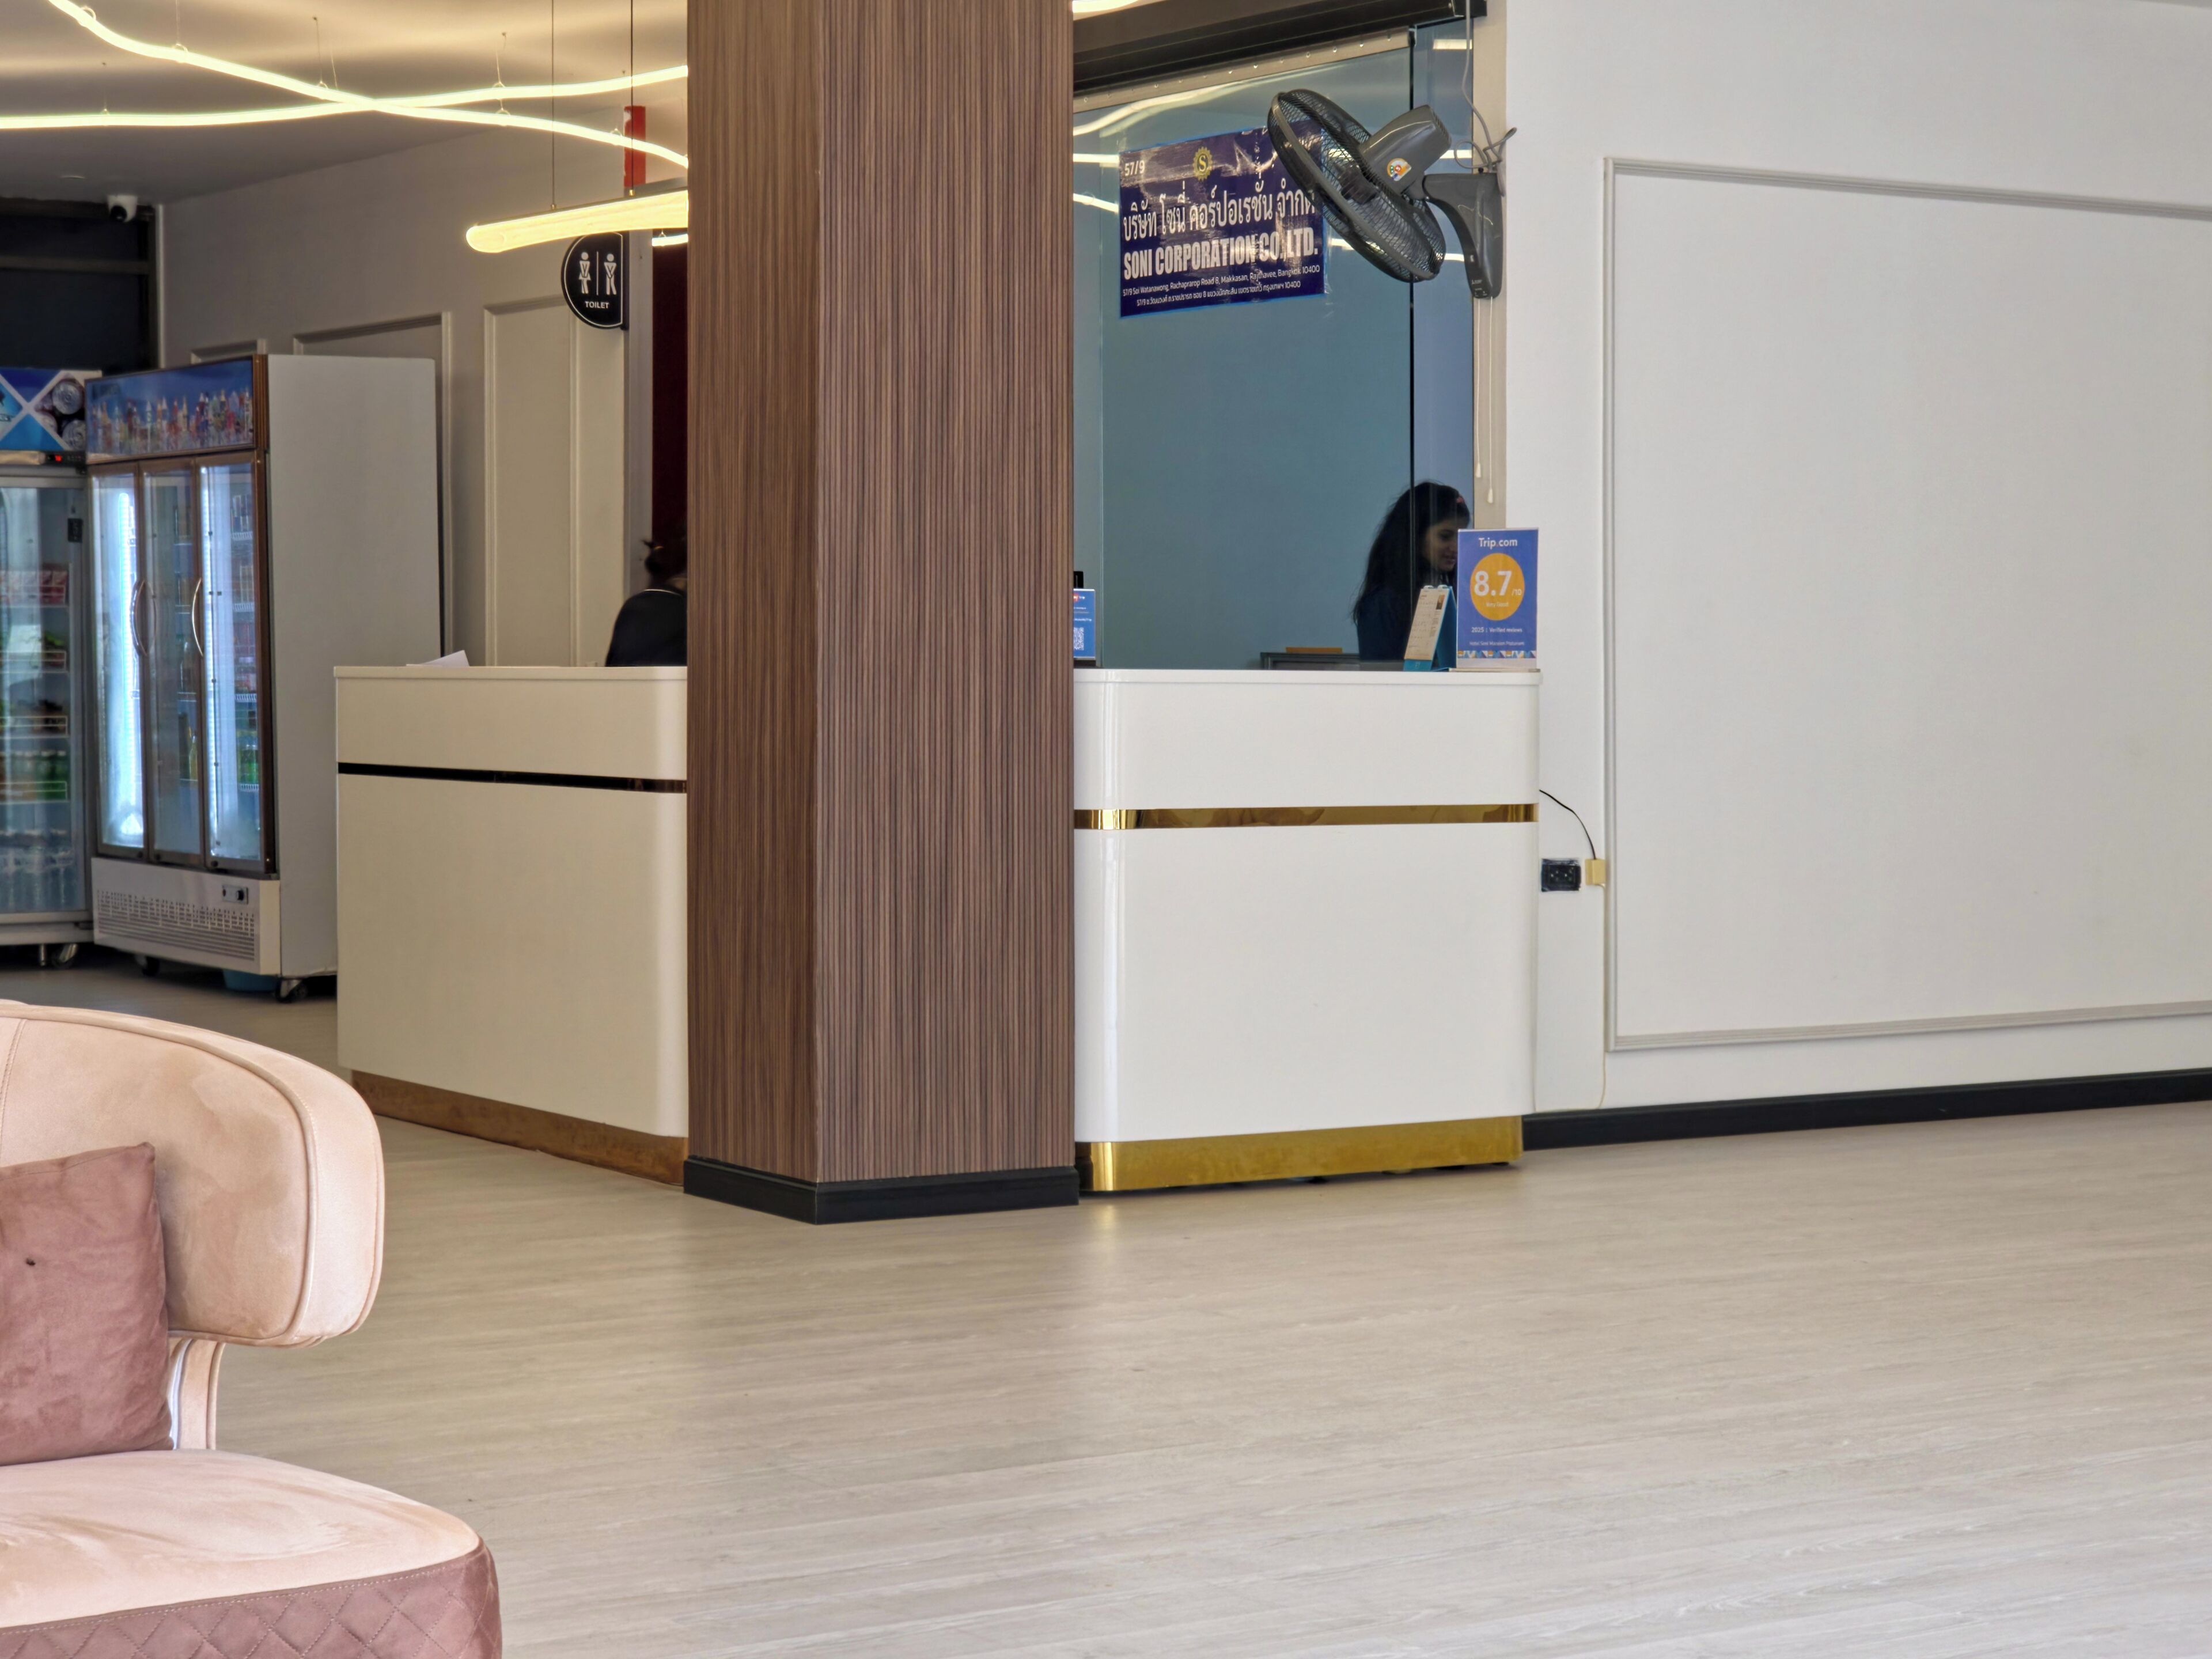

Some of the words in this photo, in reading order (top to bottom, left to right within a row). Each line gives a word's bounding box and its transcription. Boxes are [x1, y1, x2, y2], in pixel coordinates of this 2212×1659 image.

[1124, 160, 1145, 176] 57/9
[1123, 199, 1157, 241] บริษัท
[1159, 180, 1185, 235] โซนี่
[1124, 249, 1152, 281] SONI
[1155, 234, 1256, 275] CORPORATION
[1123, 288, 1132, 296] 57/9
[1170, 279, 1200, 289] Rachaprarop
[1201, 277, 1214, 285] Road
[1215, 276, 1221, 285] 8,
[1221, 273, 1249, 283] Makkasan,
[1278, 267, 1301, 278] Bangkok
[1302, 264, 1320, 274] 10400
[1285, 281, 1301, 289] 10400
[585, 301, 609, 309] TOILET
[1478, 537, 1518, 550] Trip.com
[1474, 570, 1512, 597] 8.7
